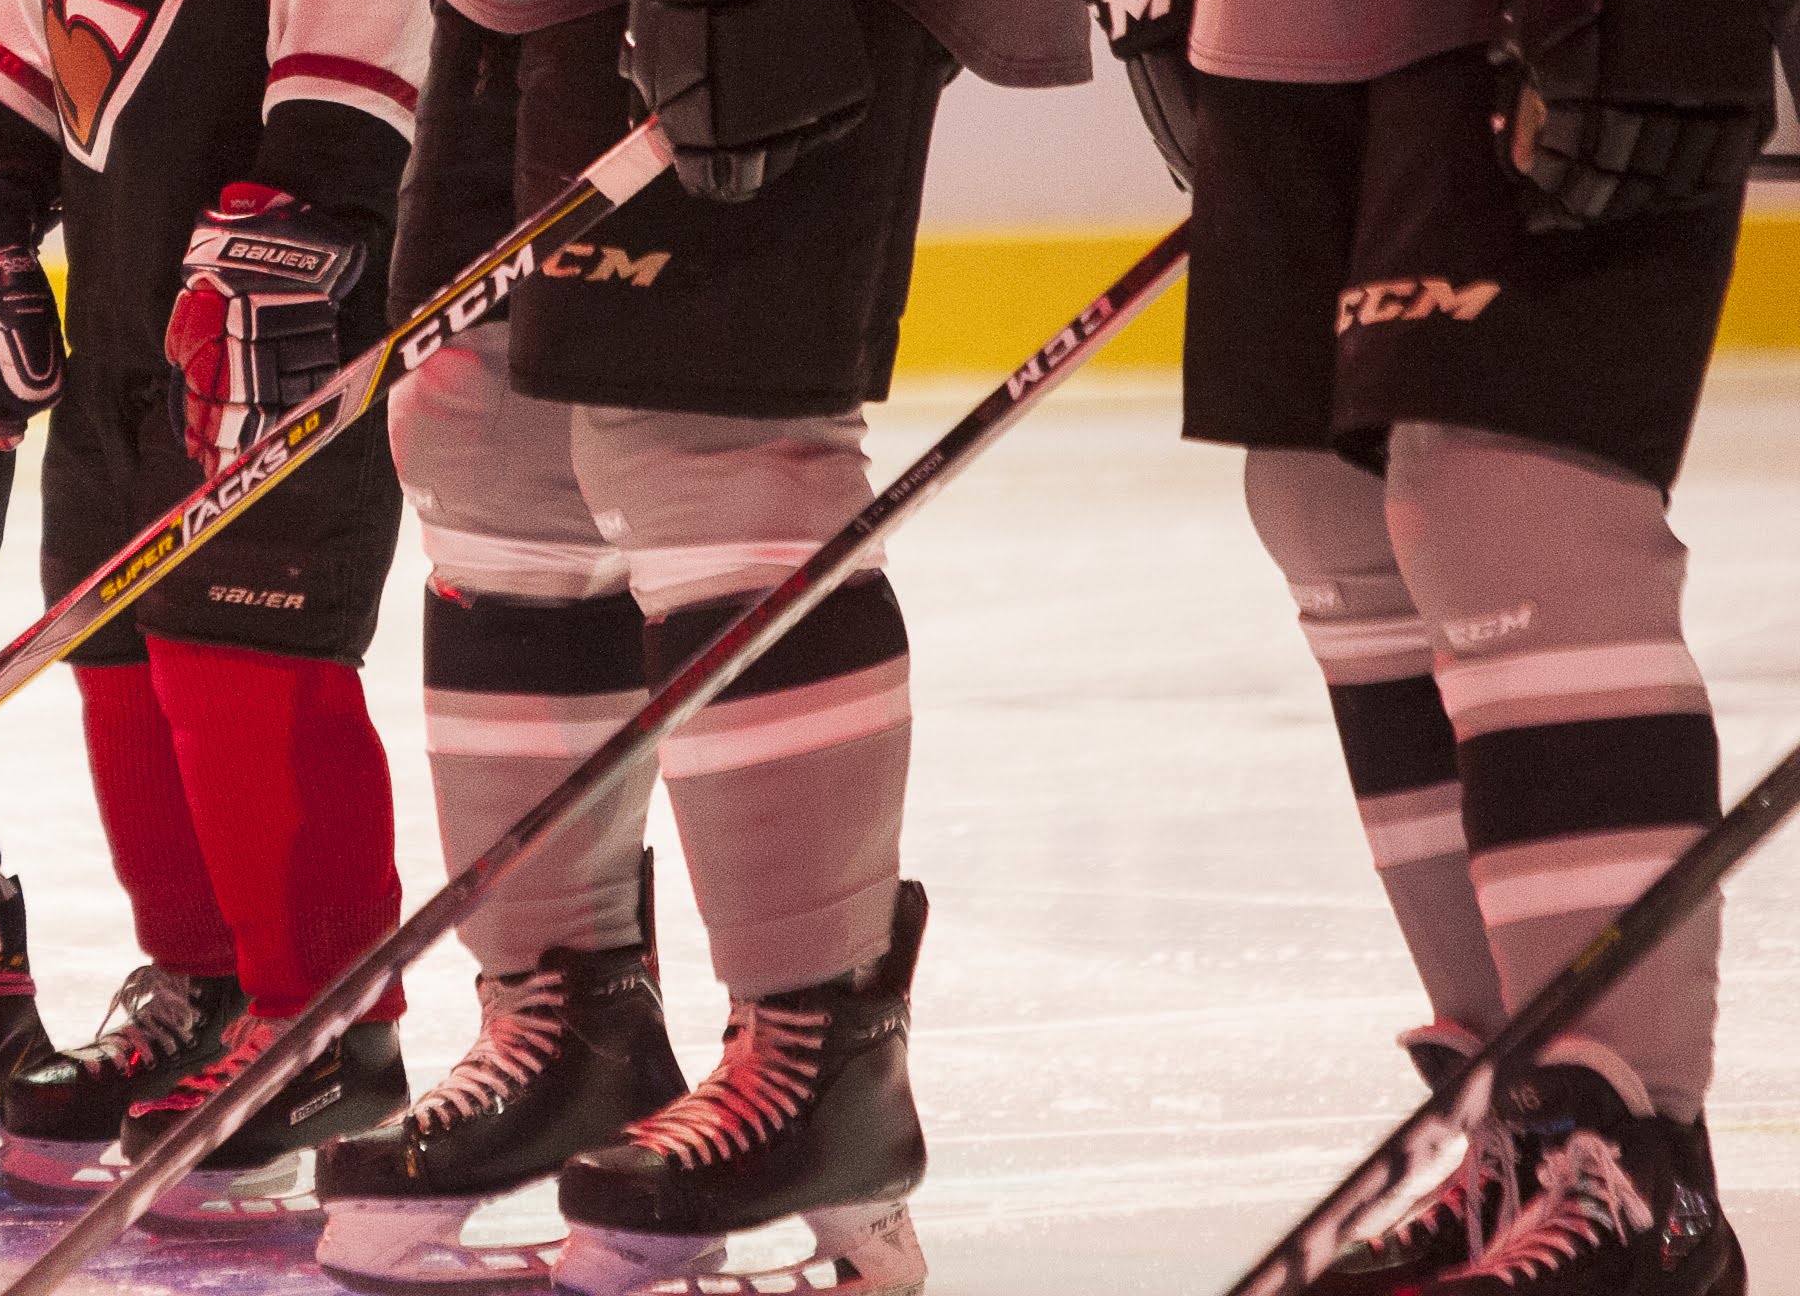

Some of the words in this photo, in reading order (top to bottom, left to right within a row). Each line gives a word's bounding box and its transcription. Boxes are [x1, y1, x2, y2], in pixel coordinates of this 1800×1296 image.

[397, 243, 536, 371] CCM
[541, 242, 673, 288] CM
[101, 533, 175, 603] SUPER
[183, 438, 290, 547] TACKS
